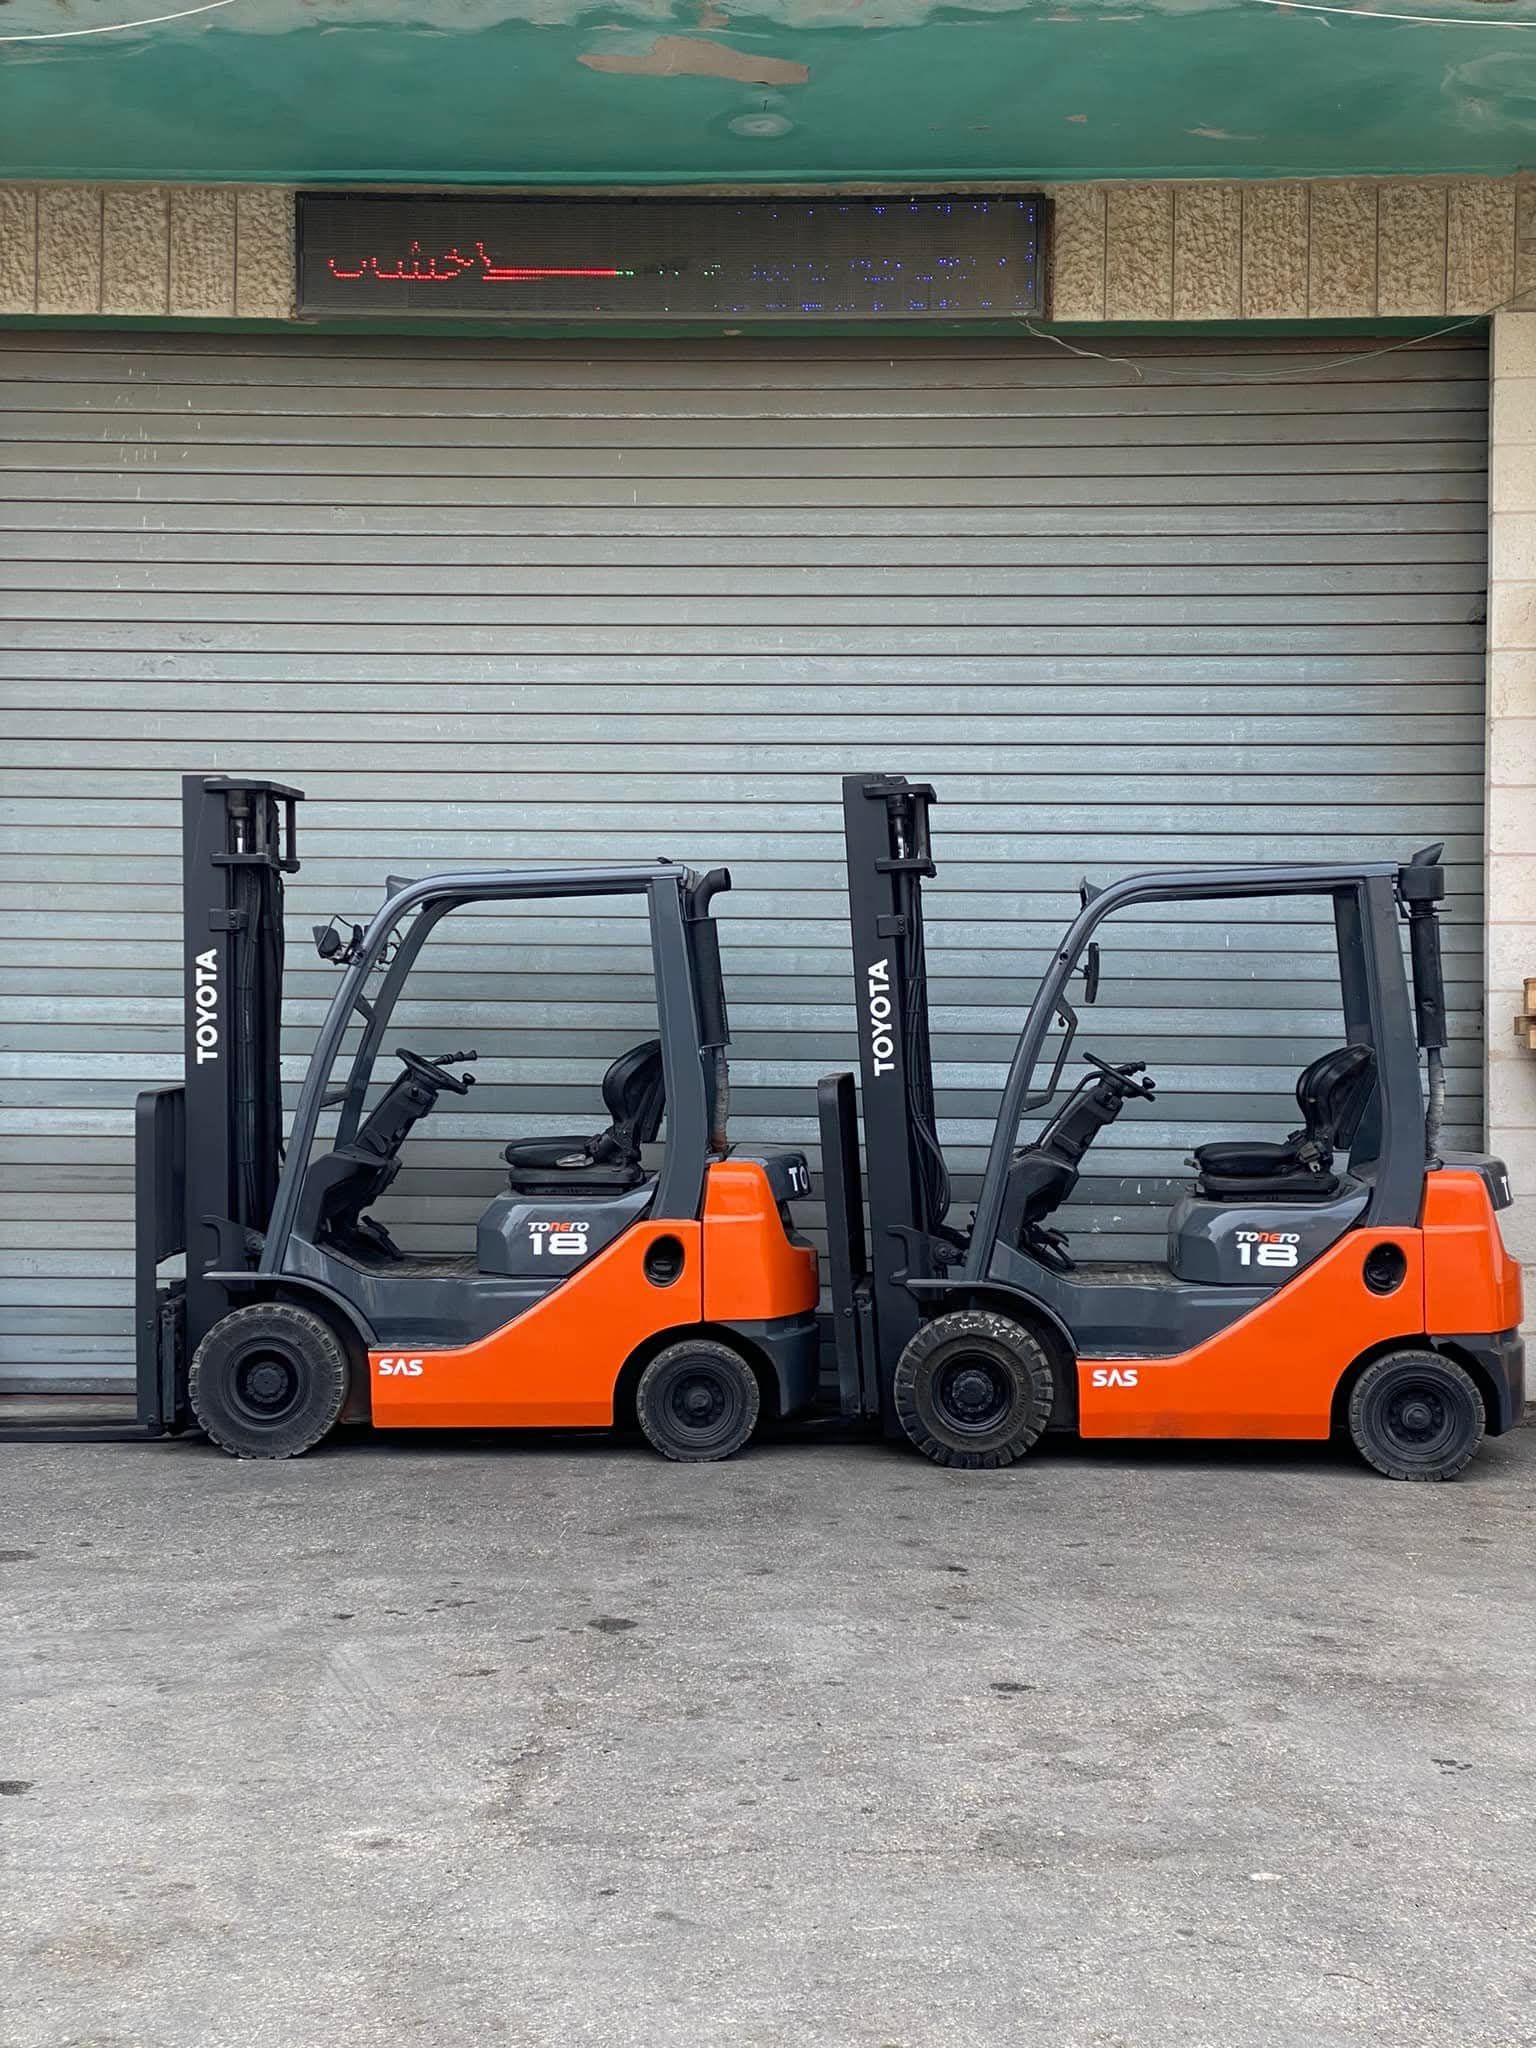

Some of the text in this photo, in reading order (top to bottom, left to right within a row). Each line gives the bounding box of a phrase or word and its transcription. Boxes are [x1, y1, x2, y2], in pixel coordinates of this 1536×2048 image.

[196, 948, 218, 1064] TOYOTA
[868, 958, 895, 1077] TOYOTA
[528, 1232, 589, 1256] 18
[1236, 1242, 1299, 1268] 18
[378, 1358, 424, 1376] SAS
[1092, 1368, 1138, 1387] SAS
